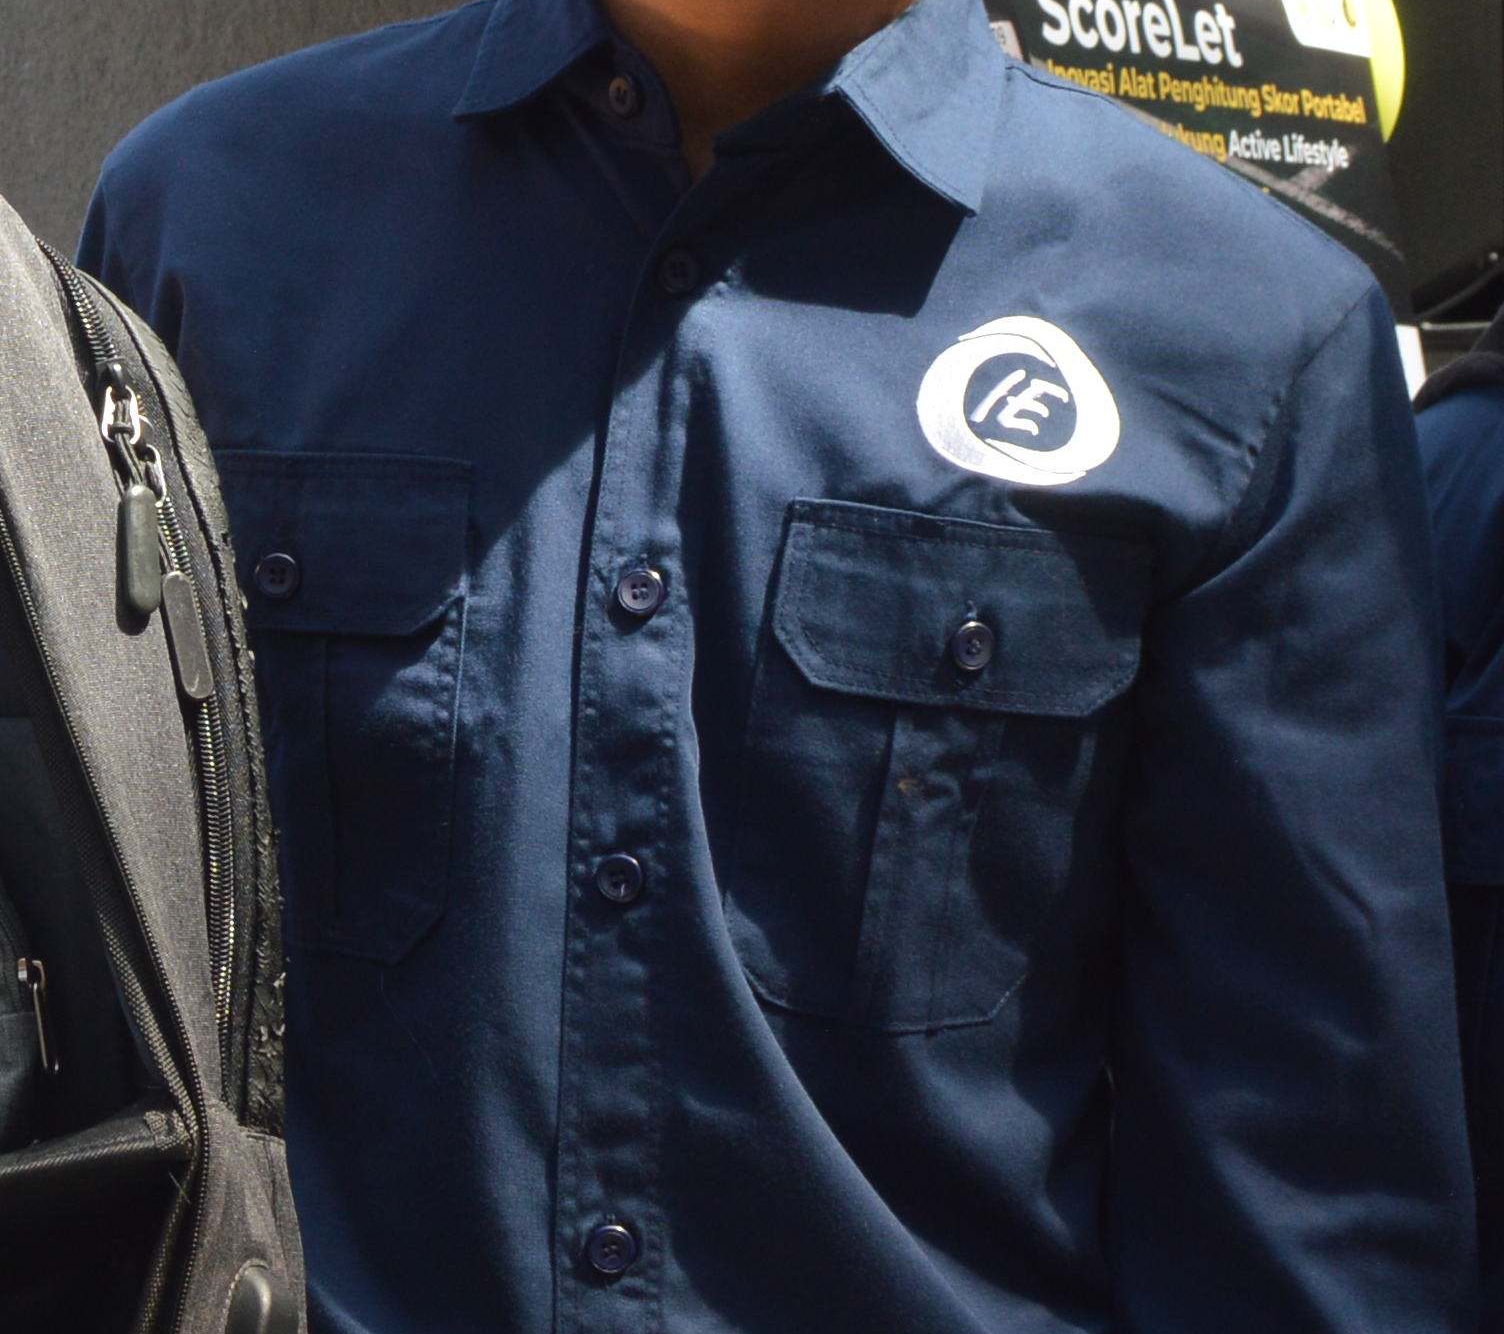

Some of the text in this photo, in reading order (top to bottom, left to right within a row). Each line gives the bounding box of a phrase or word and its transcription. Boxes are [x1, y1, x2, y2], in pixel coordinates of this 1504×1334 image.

[1119, 67, 1156, 100] Alat
[1158, 72, 1262, 117] Penghitung
[1261, 84, 1301, 116] Skor
[1301, 88, 1368, 125] Portabel
[1228, 129, 1283, 163] Active
[1282, 133, 1351, 173] Lifestyle
